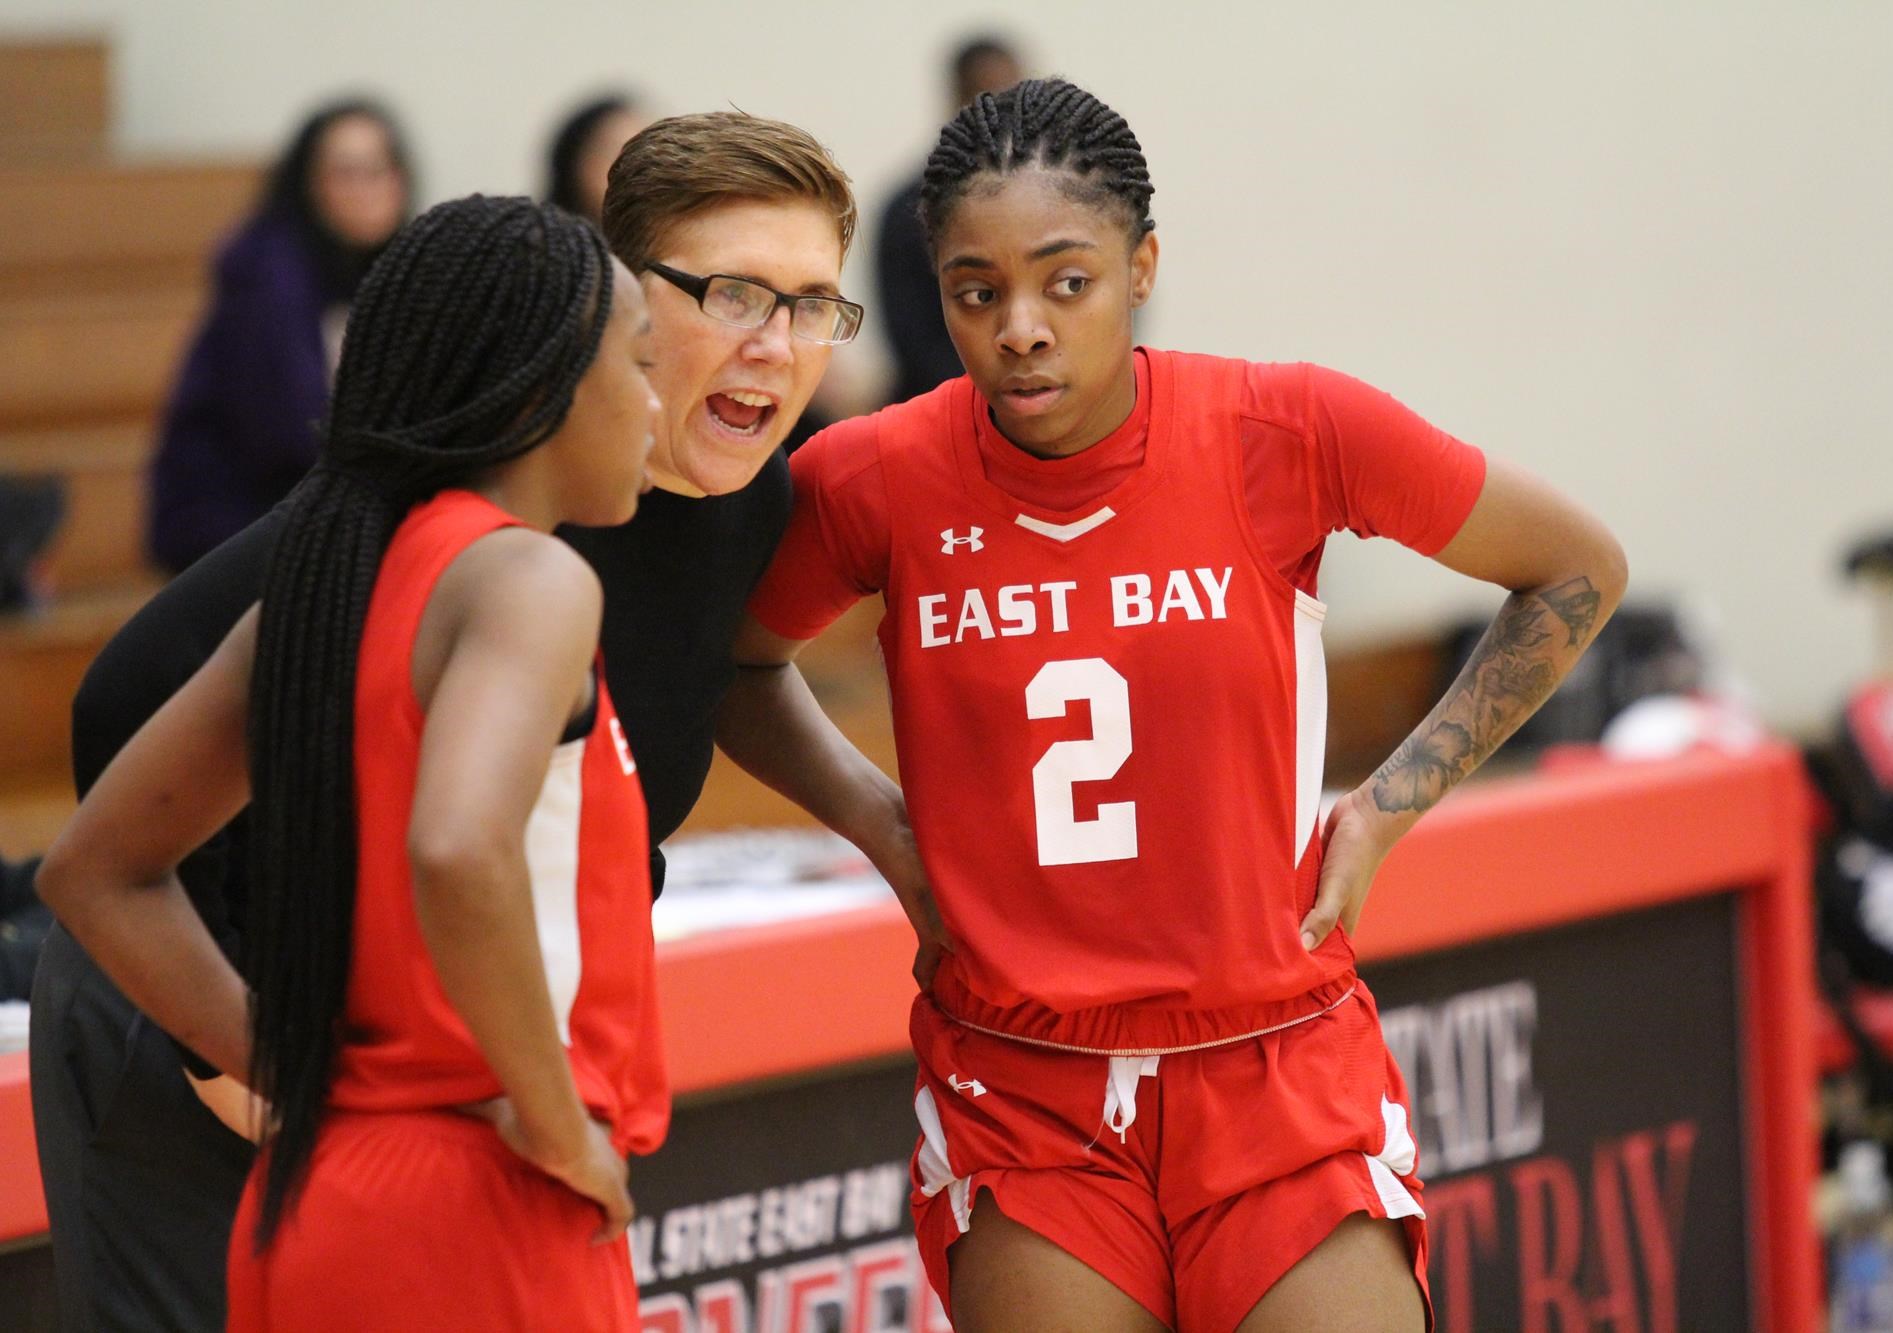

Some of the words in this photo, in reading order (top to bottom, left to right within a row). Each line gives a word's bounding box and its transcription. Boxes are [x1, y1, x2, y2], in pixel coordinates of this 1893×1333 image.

[918, 581, 1077, 649] EAST
[1110, 566, 1233, 627] BAY
[1025, 657, 1138, 866] 2
[1380, 979, 1544, 1181] TATE
[660, 1192, 757, 1279] STATE
